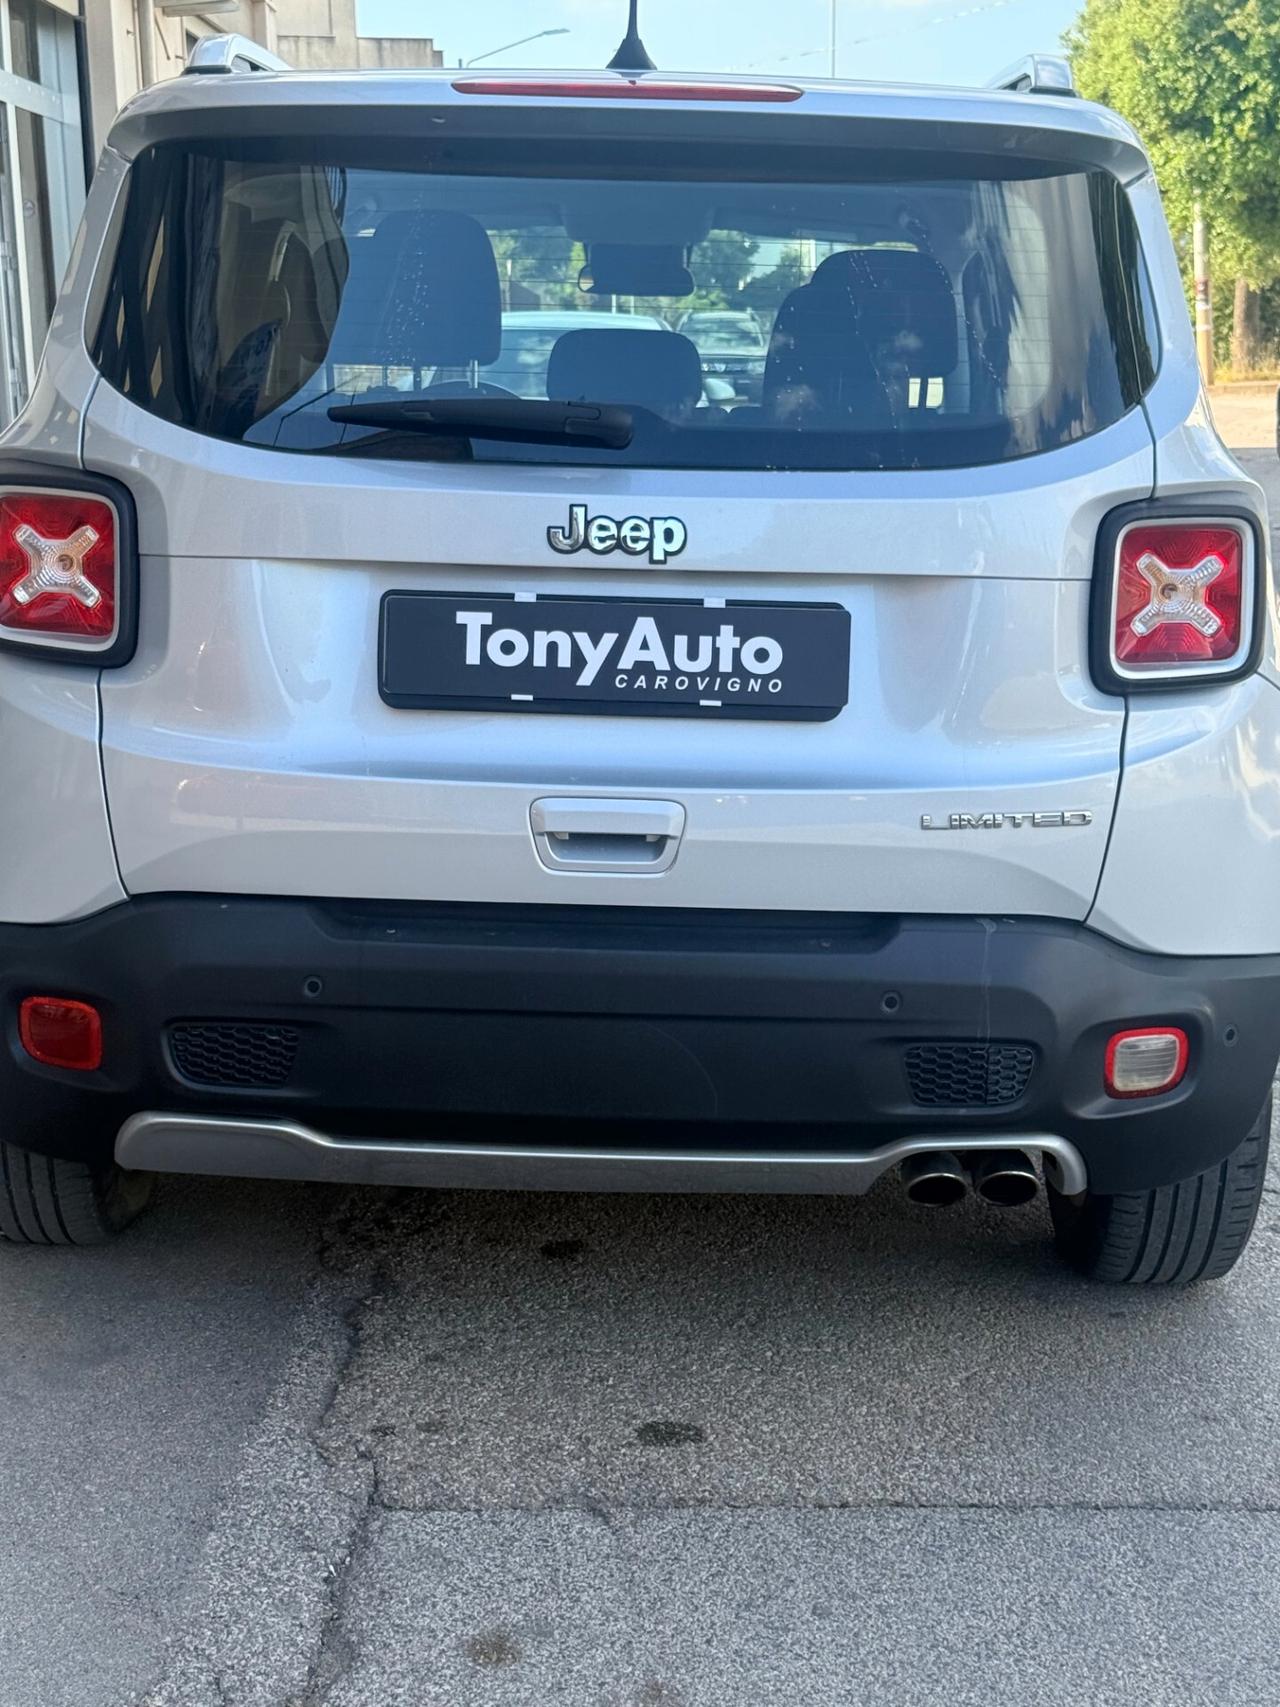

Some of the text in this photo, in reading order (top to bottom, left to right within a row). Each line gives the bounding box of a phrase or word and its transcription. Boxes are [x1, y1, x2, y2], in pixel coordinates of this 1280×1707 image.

[547, 504, 687, 564] Jeep
[455, 611, 784, 686] TonyAuto
[614, 674, 783, 694] CAROVIGNO
[921, 810, 1093, 830] LIMITED
